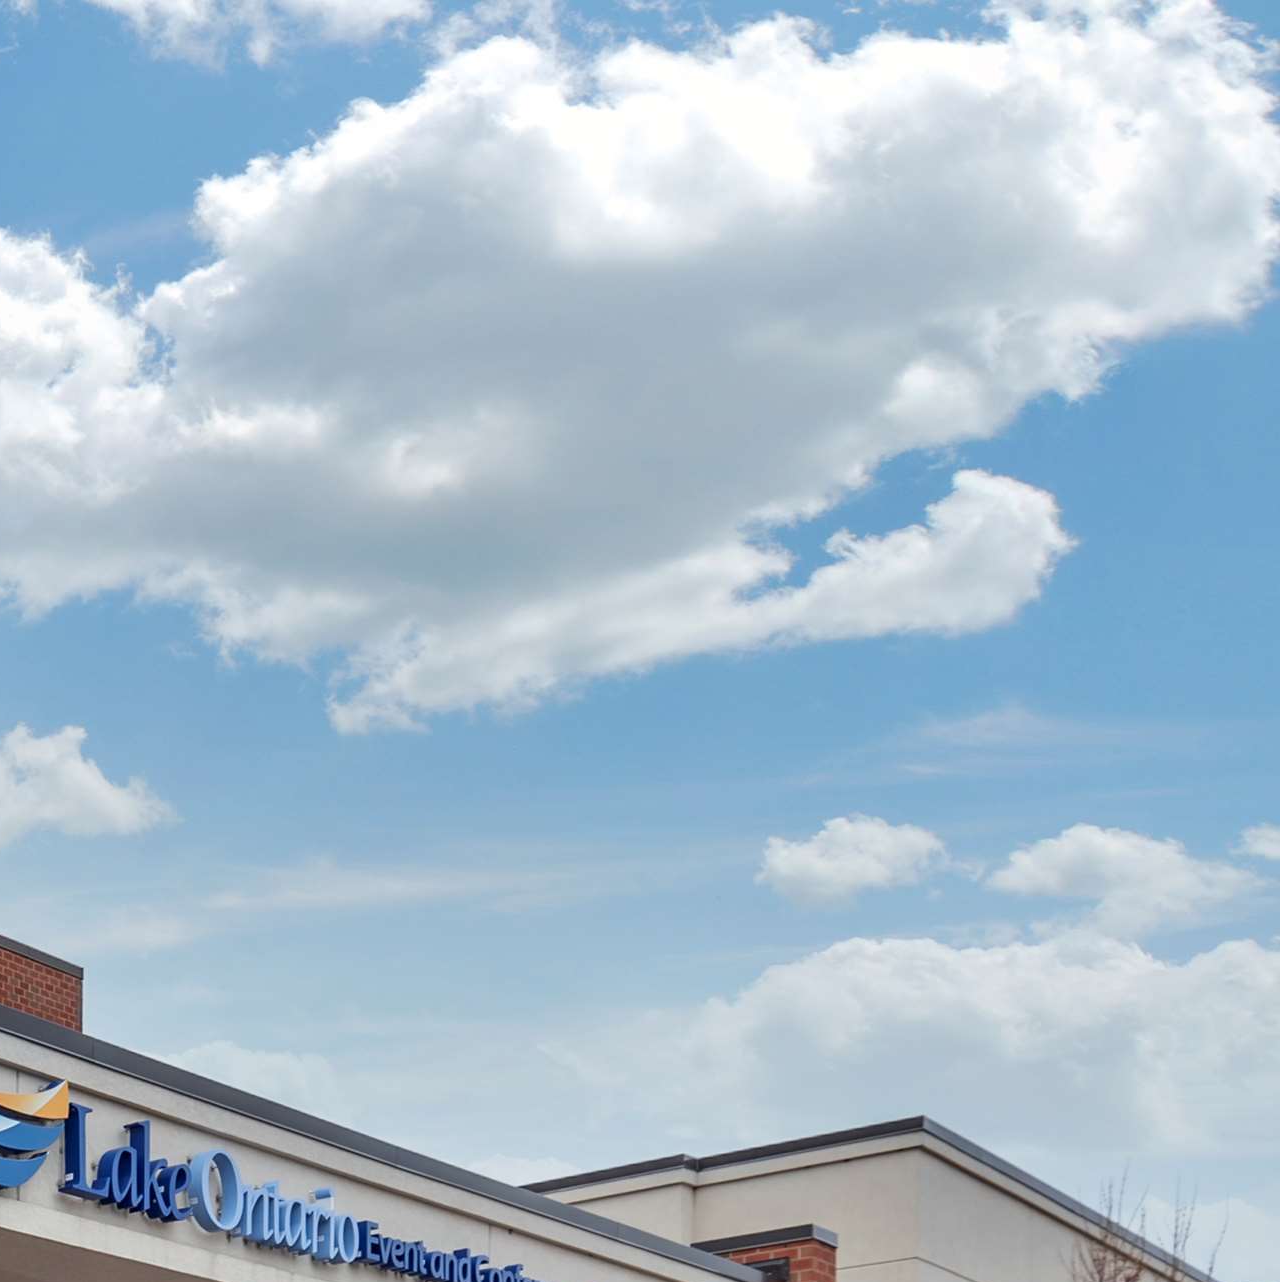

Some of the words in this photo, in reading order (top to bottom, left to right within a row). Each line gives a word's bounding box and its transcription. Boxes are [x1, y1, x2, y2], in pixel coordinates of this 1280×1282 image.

[58, 1102, 192, 1223] Lake
[191, 1150, 361, 1265] Ontario
[358, 1220, 428, 1279] Event
